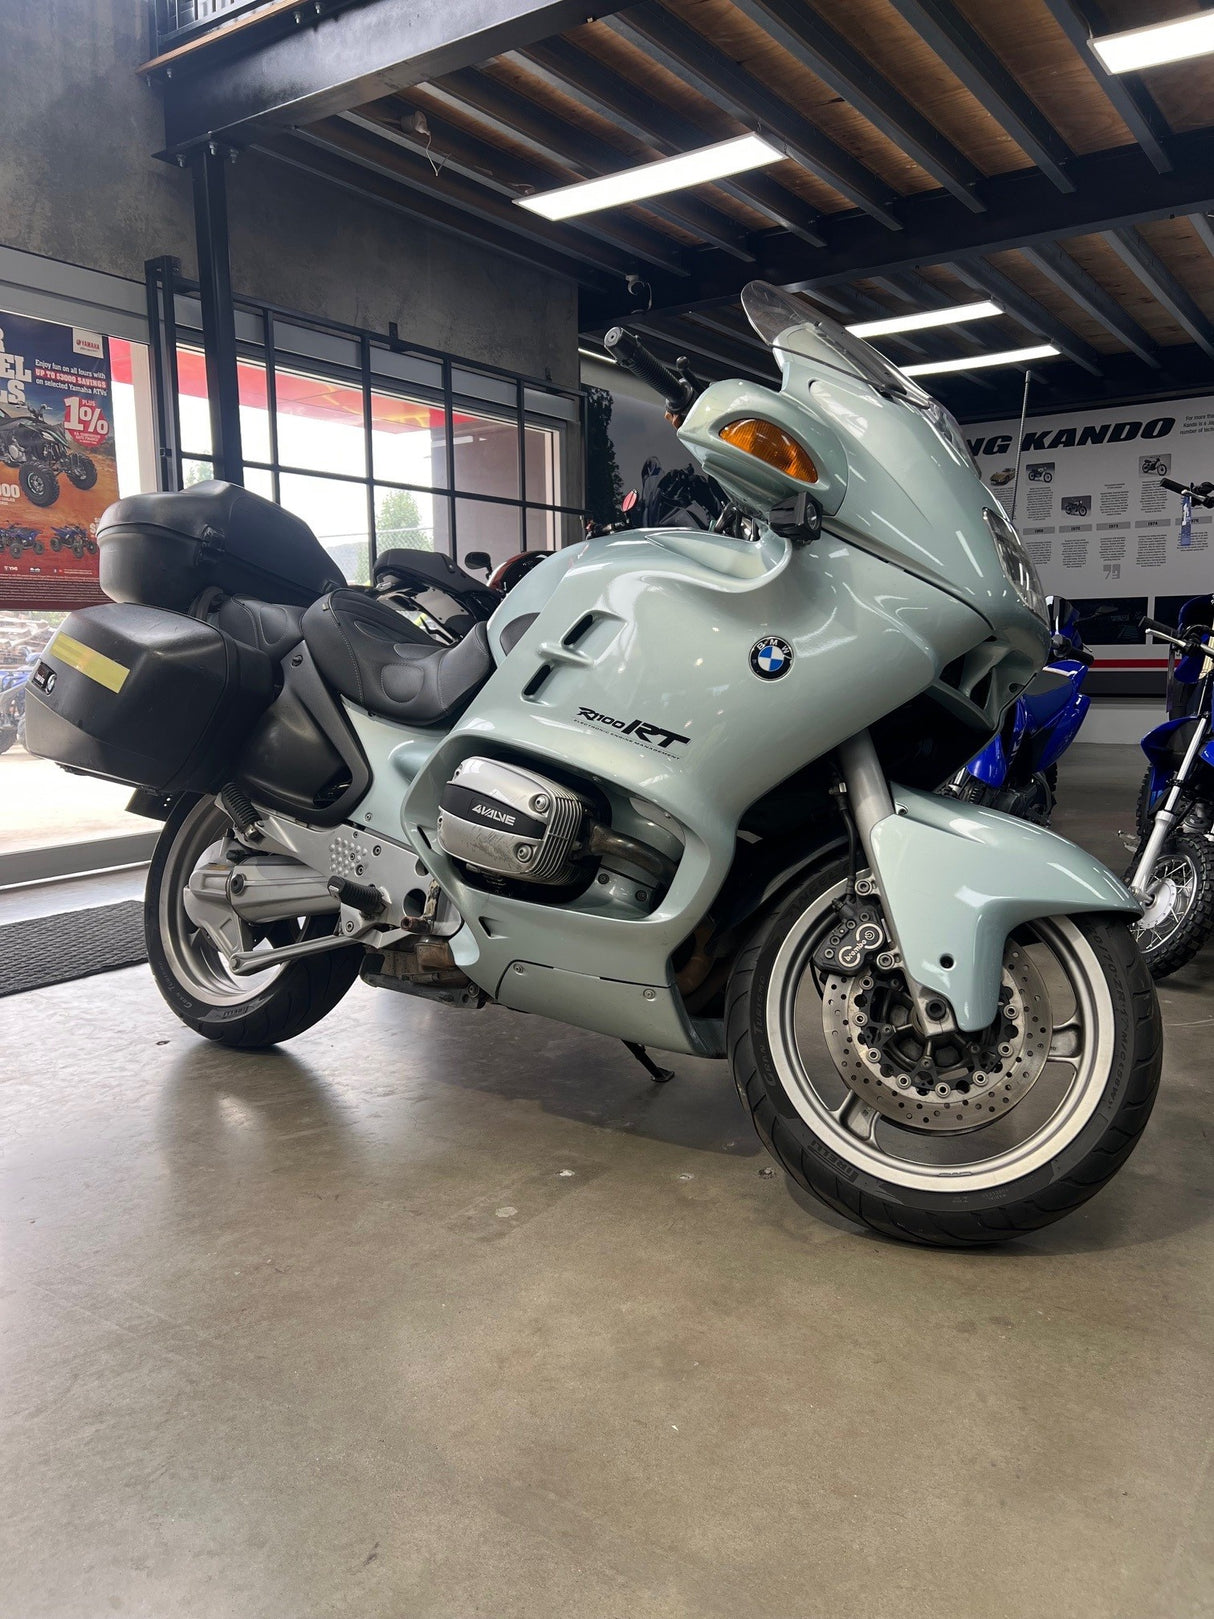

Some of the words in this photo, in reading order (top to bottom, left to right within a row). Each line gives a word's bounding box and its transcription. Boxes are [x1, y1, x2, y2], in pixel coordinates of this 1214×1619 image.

[81, 340, 100, 350] YAMAHA
[35, 359, 51, 369] Enjoy
[52, 362, 62, 371] fun
[70, 366, 78, 375] all
[92, 371, 106, 380] with
[35, 368, 46, 376] UP
[46, 370, 56, 379] TO
[56, 373, 77, 383] $3000
[77, 377, 107, 389] SAVINGS
[44, 380, 68, 390] selected
[69, 384, 92, 394] Yamaha
[82, 399, 96, 407] PLUS
[64, 396, 109, 434] 1%
[1019, 417, 1176, 452] KANDO
[757, 639, 790, 654] BMW
[573, 719, 609, 735] ELECTRONIC
[610, 732, 632, 743] ENGINE
[634, 741, 680, 760] MANAGEMENT
[845, 939, 867, 962] brembo
